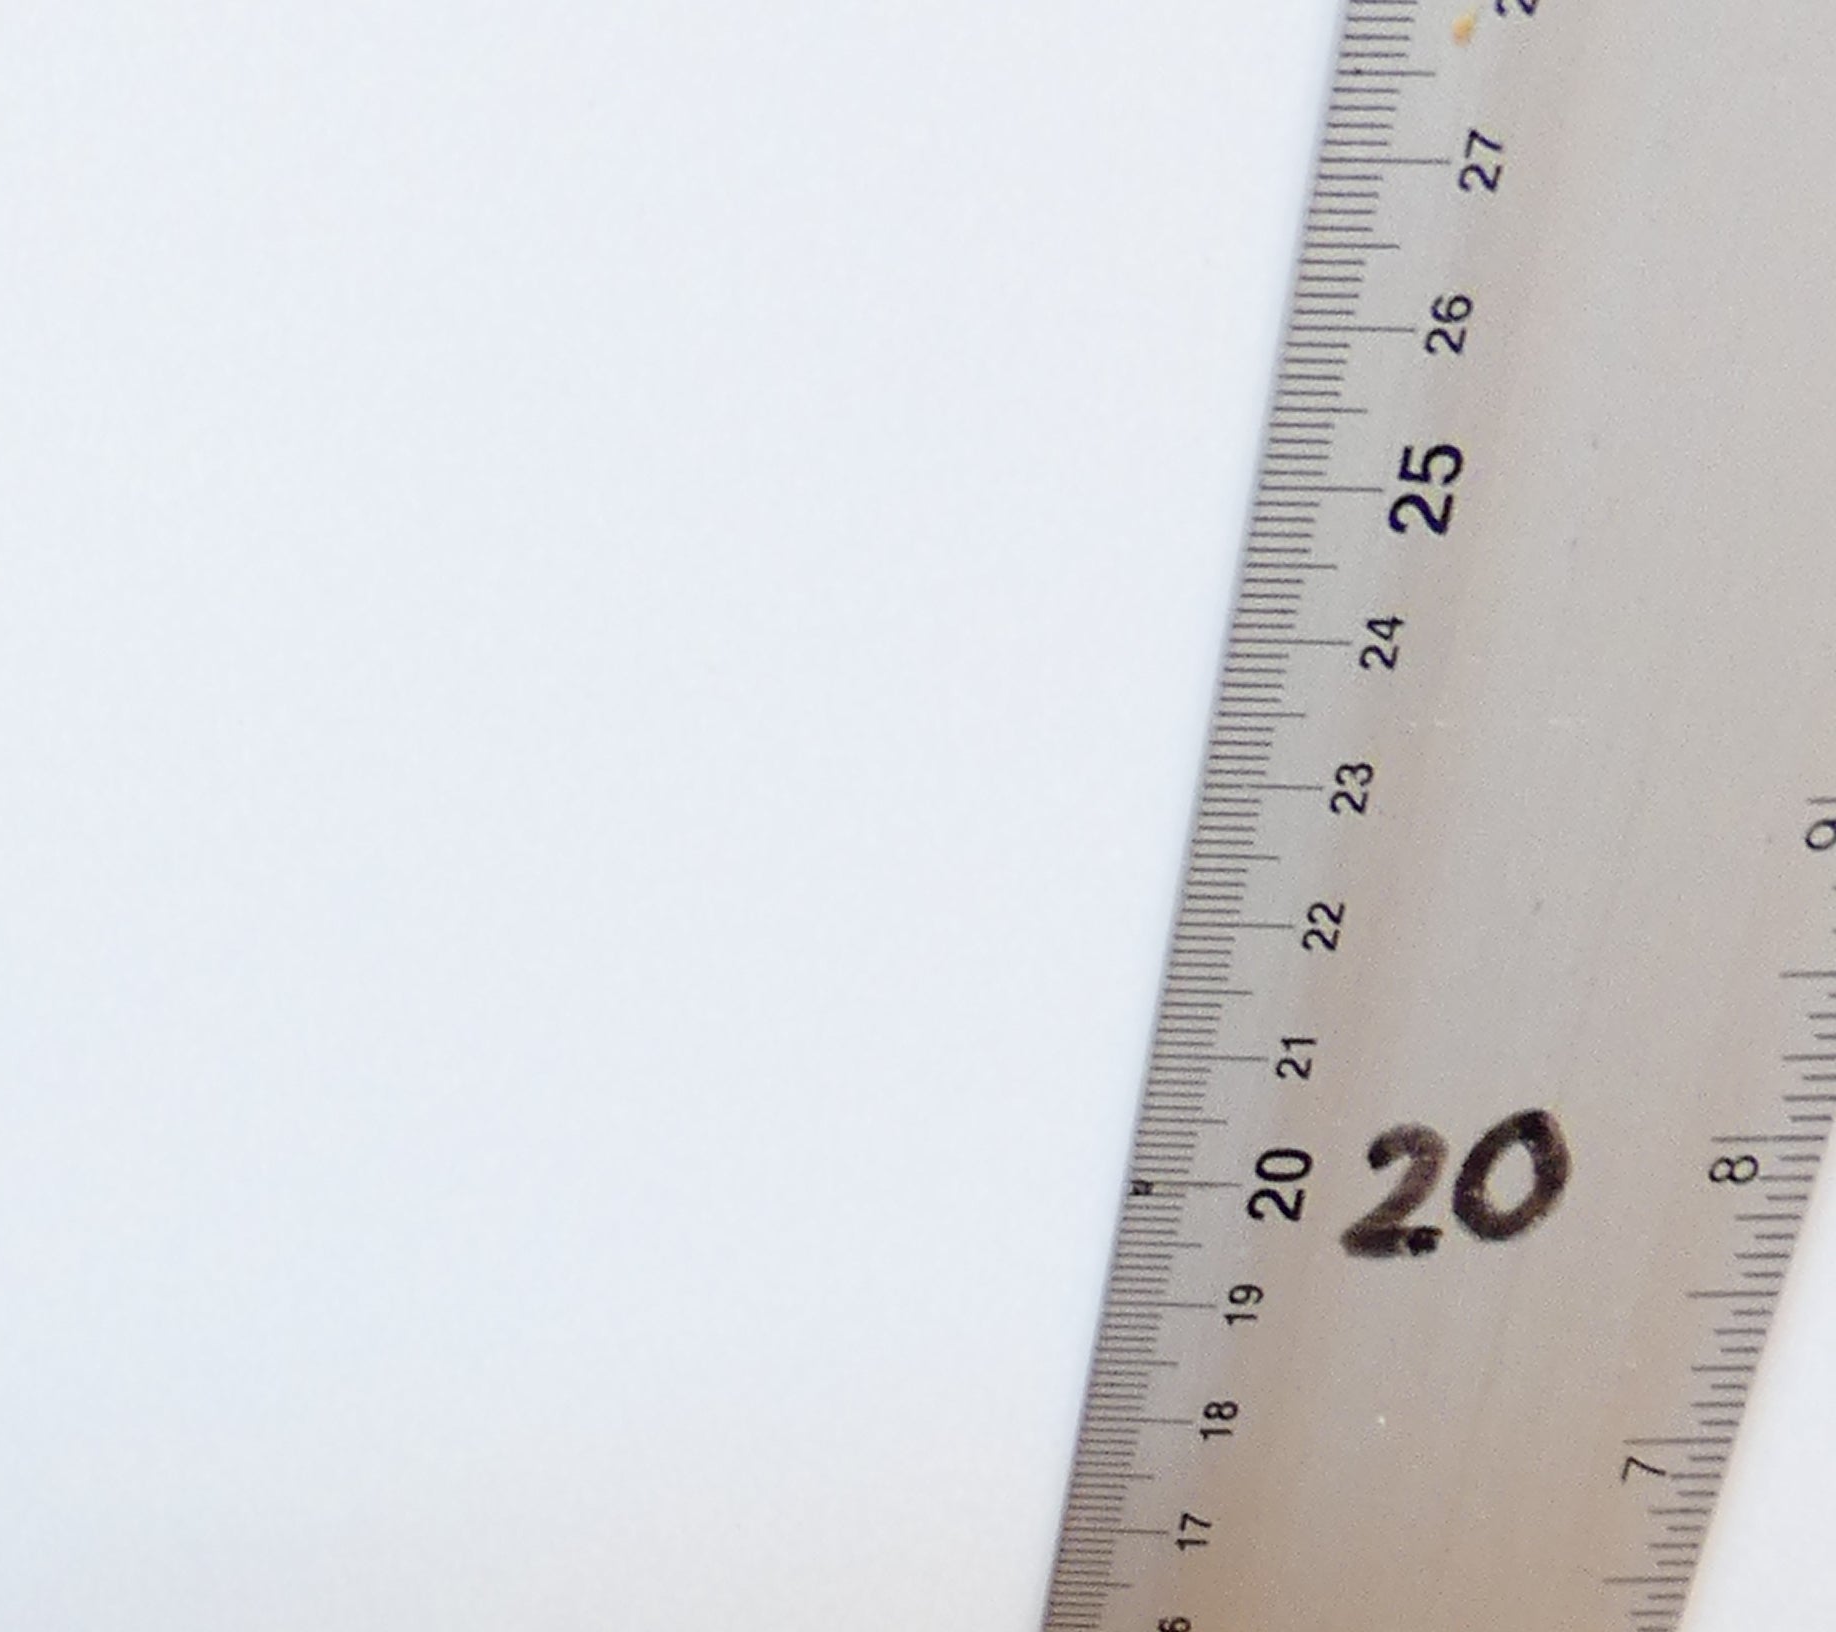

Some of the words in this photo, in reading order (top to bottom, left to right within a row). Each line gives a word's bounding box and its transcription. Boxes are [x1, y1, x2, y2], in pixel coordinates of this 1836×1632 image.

[1458, 129, 1503, 193] 27
[1423, 294, 1474, 355] 26
[1387, 443, 1464, 536] 25
[1358, 615, 1405, 671] 24
[1329, 762, 1375, 815] 23
[1301, 901, 1346, 952] 22
[1274, 1034, 1317, 1081] 21
[1245, 1147, 1314, 1223] 20
[1339, 1108, 1573, 1259] 20
[1709, 1155, 1759, 1184] 8
[1223, 1283, 1265, 1326] 19
[1199, 1400, 1239, 1441] 18
[1620, 1456, 1667, 1483] 7
[1174, 1512, 1213, 1552] 17
